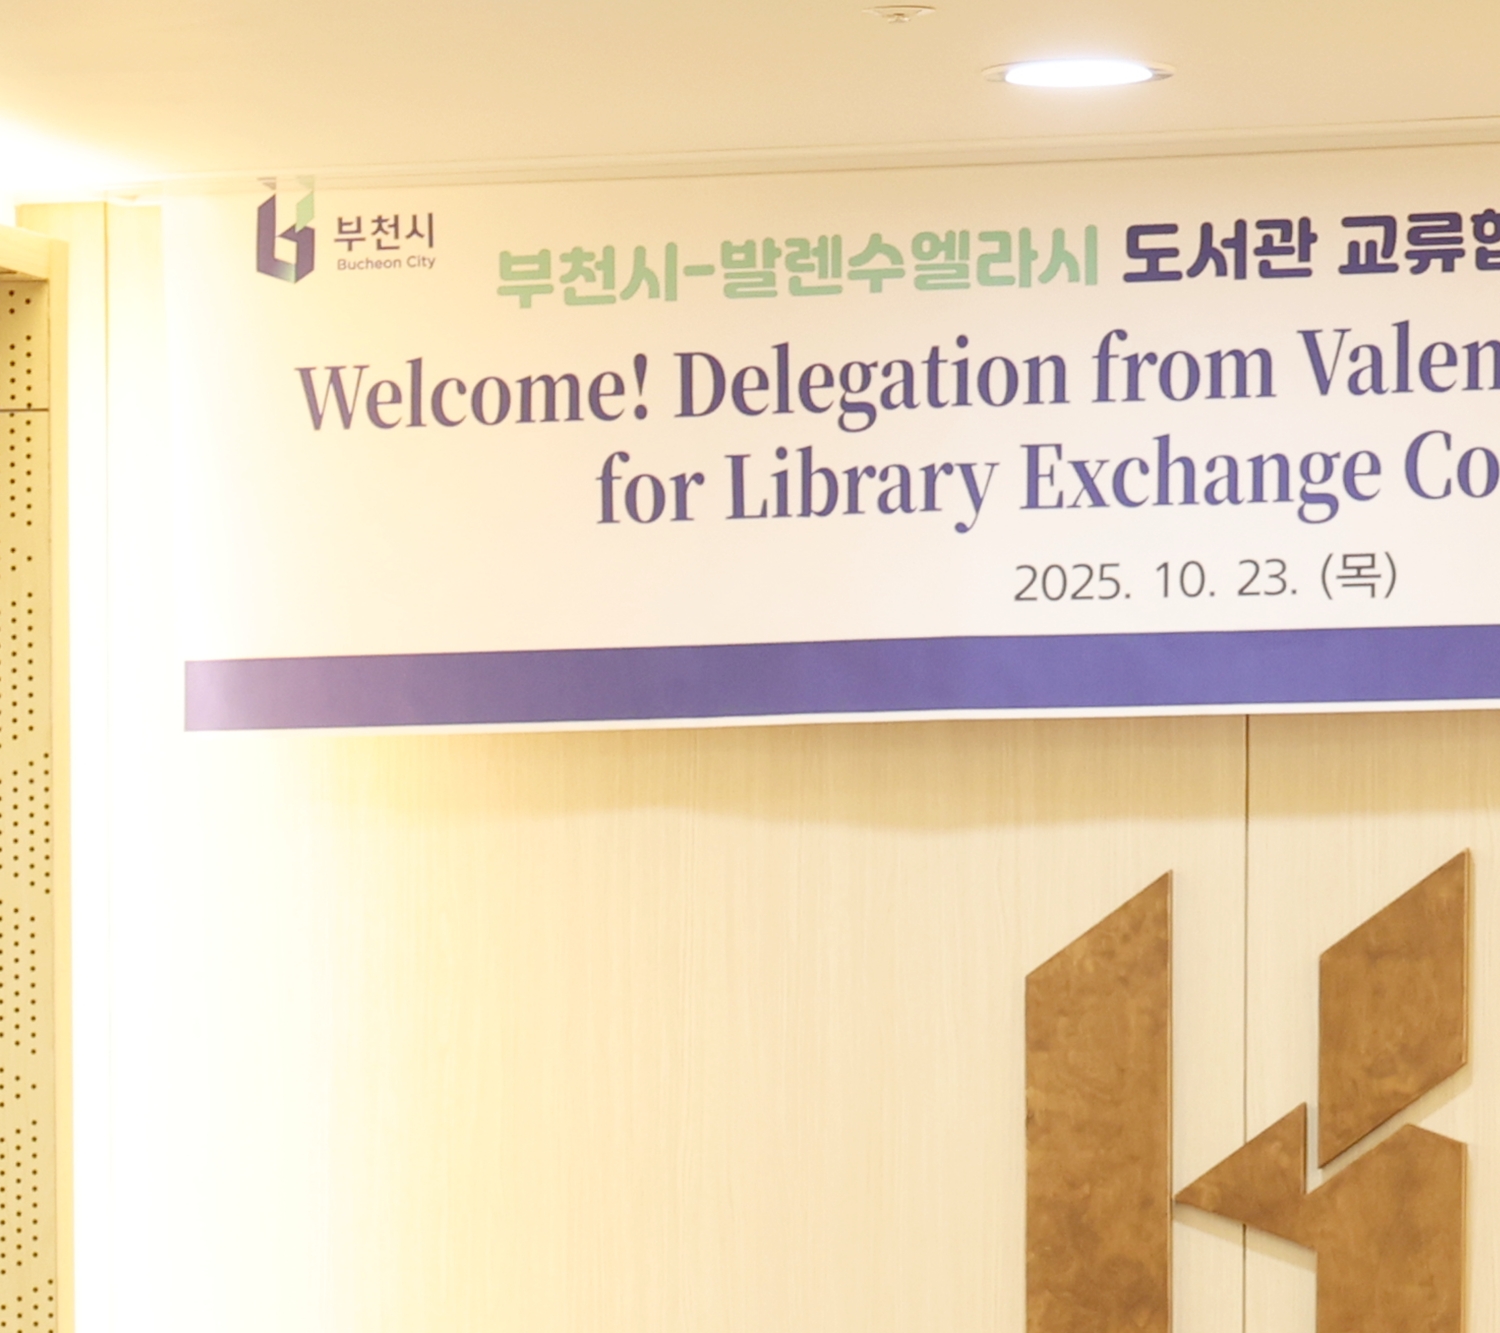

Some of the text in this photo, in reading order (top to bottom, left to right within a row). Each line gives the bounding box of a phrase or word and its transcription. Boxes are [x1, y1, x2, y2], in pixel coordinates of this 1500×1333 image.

[333, 212, 436, 252] 부천시
[336, 253, 437, 272] Bucheon City
[497, 223, 1098, 309] 부천시-발렌수엘라시
[1121, 215, 1319, 285] 도서관
[294, 352, 649, 432] Welcome!
[672, 333, 1071, 434] Delegation
[1091, 328, 1279, 404] from
[595, 450, 707, 525] for
[723, 445, 1001, 535] Library
[1019, 431, 1384, 525] Exchange
[1013, 551, 1398, 602] 2025. 10. 23. (목)
